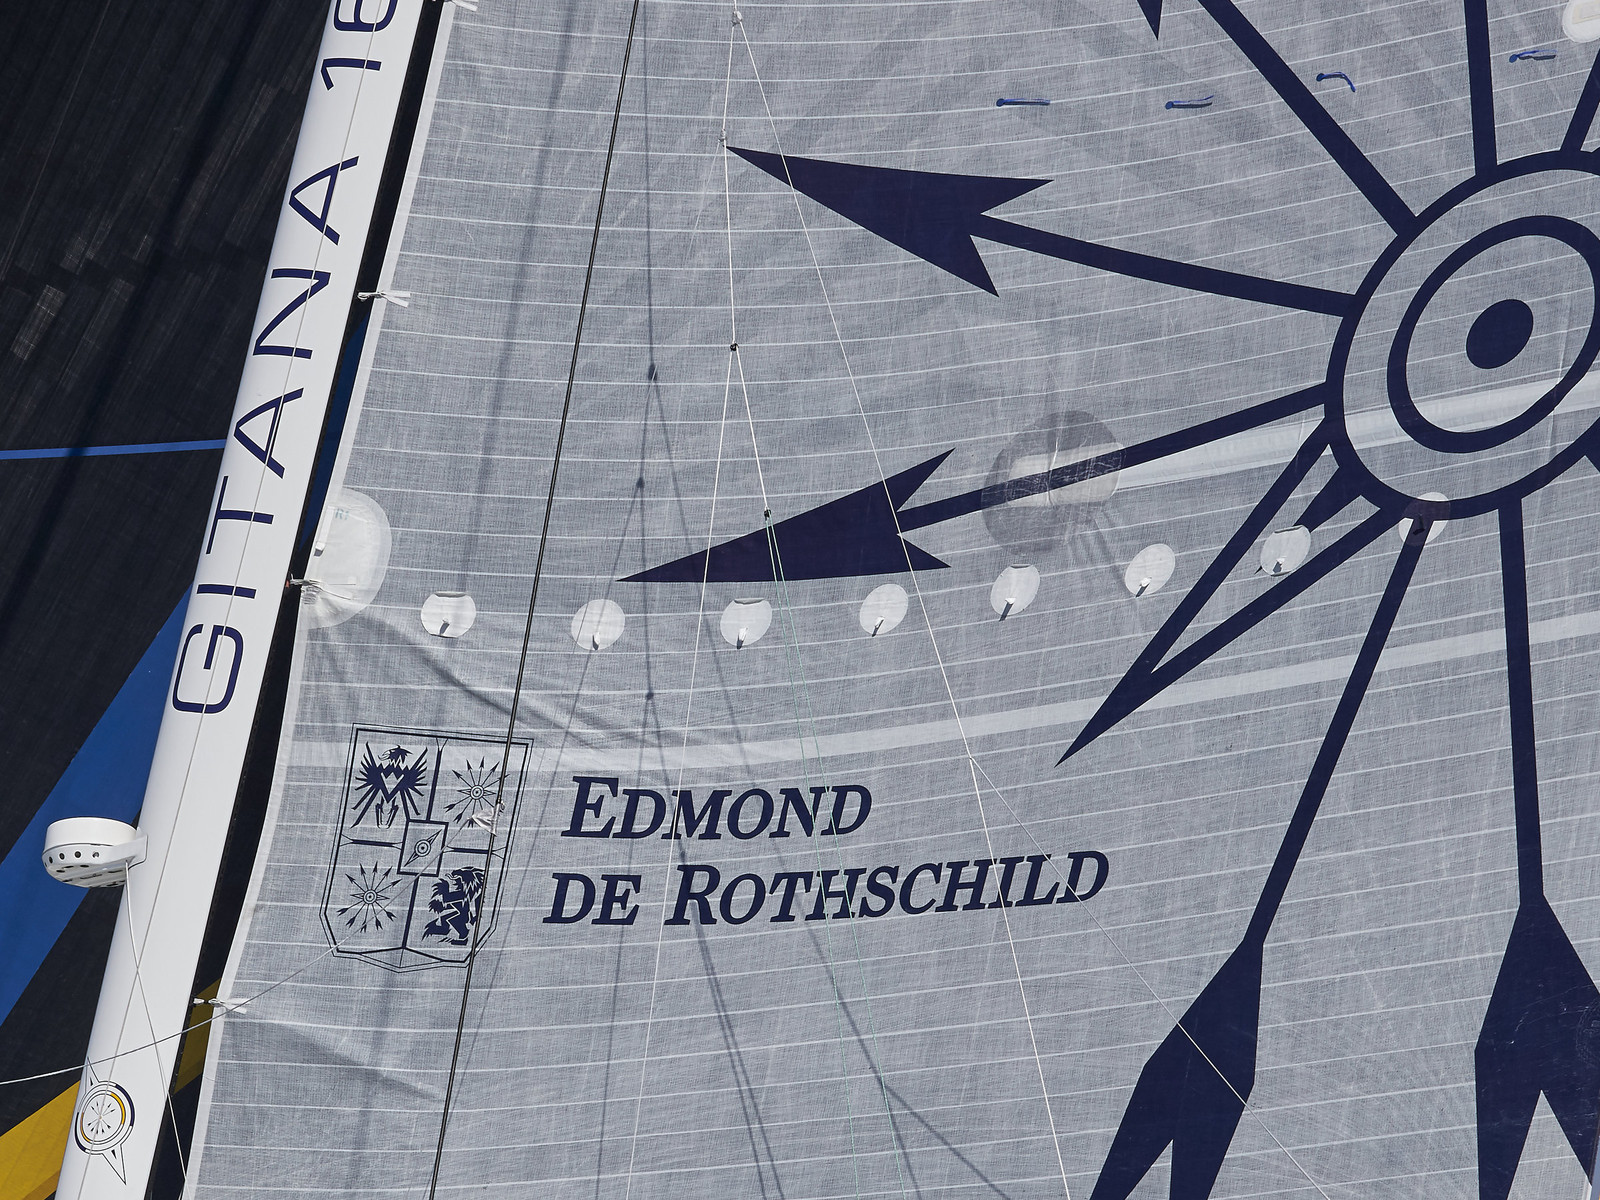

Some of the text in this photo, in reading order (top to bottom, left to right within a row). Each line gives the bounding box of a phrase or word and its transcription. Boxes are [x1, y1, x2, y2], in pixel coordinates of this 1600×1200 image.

[171, 155, 360, 714] GITANA
[561, 775, 872, 840] EDMOND
[542, 850, 1110, 925] DE ROTHSCHILD
